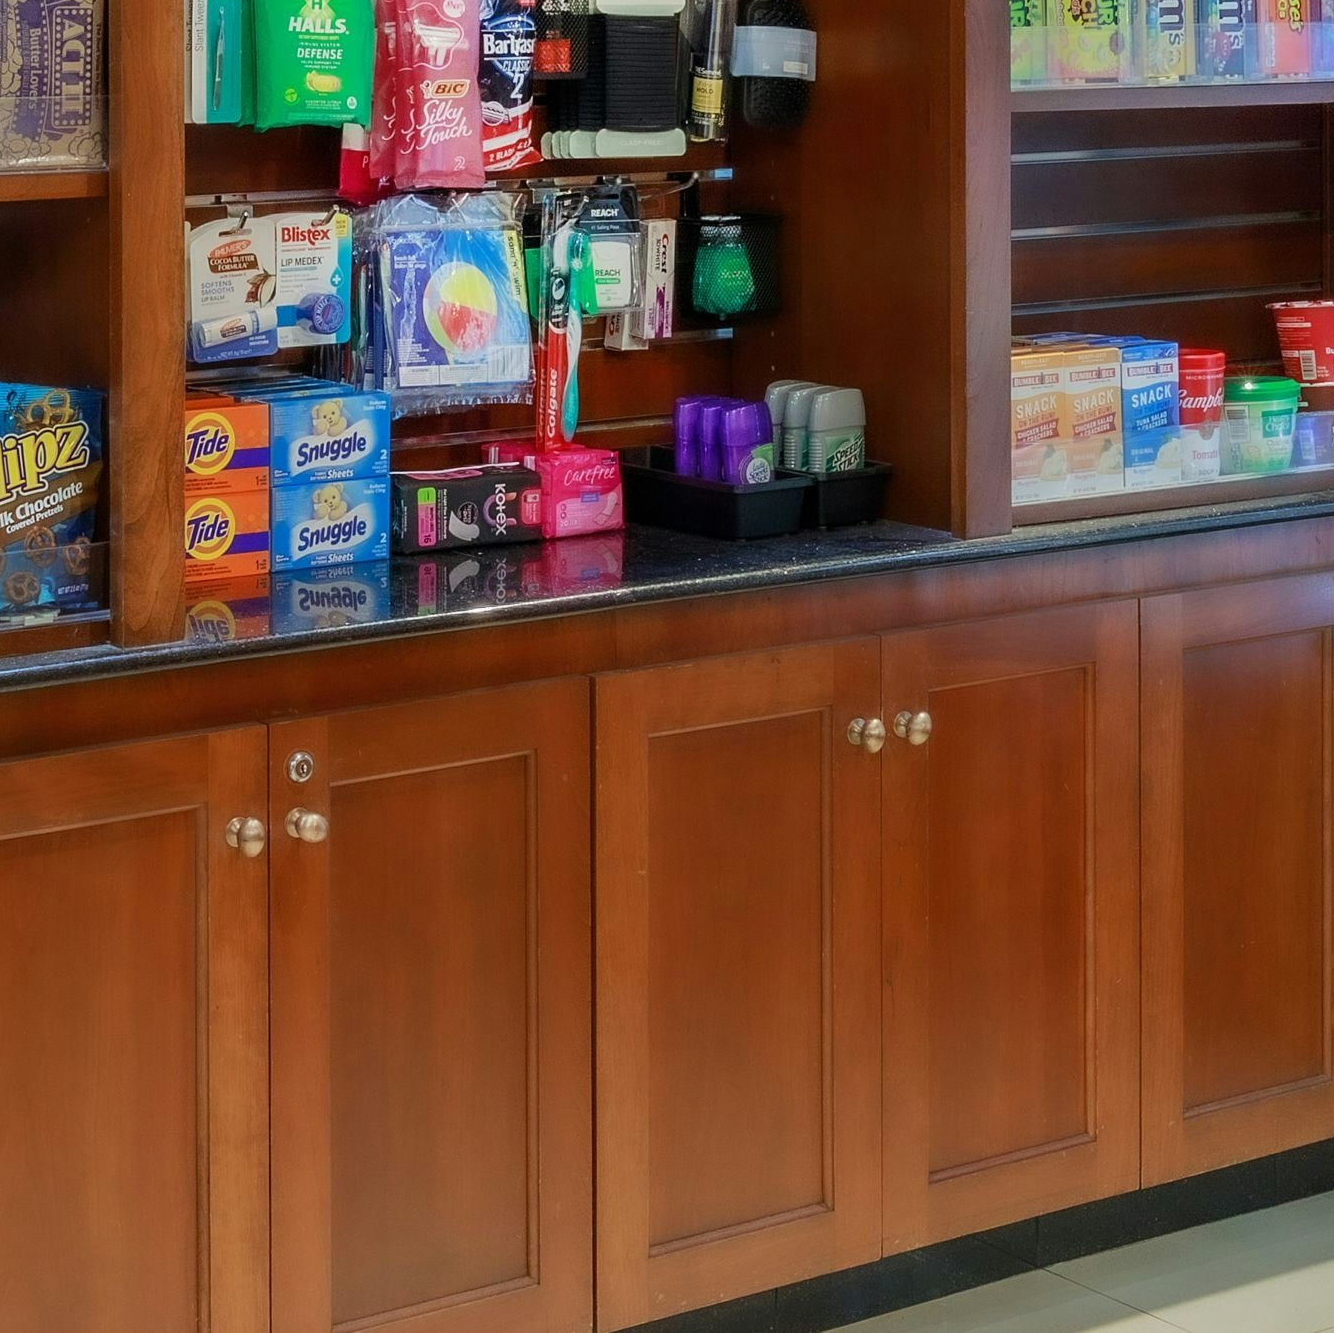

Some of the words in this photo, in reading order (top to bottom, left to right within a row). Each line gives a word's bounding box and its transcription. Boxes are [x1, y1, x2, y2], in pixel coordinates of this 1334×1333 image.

[29, 28, 42, 68] Butter
[61, 18, 87, 77] ACT
[194, 28, 205, 53] Slant
[296, 47, 344, 60] DEFENSE
[28, 69, 43, 110] Lovers
[416, 99, 464, 131] Silky
[416, 121, 473, 152] Touch
[590, 208, 619, 217] REACH
[280, 226, 331, 247] Blistex
[280, 258, 293, 267] LIP
[294, 256, 323, 267] MEDEX
[594, 268, 621, 277] REACH
[200, 280, 233, 290] SOFTENS
[200, 286, 235, 297] SMOOTHS
[1071, 370, 1097, 381] BUMBLE
[1100, 368, 1116, 377] BEE
[1128, 366, 1155, 376] BUMBLE
[1159, 364, 1173, 373] BEE
[547, 368, 558, 439] Colgate
[1016, 394, 1058, 419] SNACK
[1073, 388, 1114, 413] SNACK
[1131, 383, 1172, 408] SNACK
[185, 428, 230, 466] Tide
[296, 431, 367, 467] Snuggle
[379, 449, 388, 460] 2
[327, 468, 354, 479] Sheets
[15, 480, 84, 519] Chocolate
[6, 514, 36, 534] Covered
[36, 504, 64, 522] Pretzels
[186, 513, 230, 552] Tide
[297, 515, 367, 552] Snuggle
[379, 532, 388, 543] 2
[327, 552, 354, 563] Sheets
